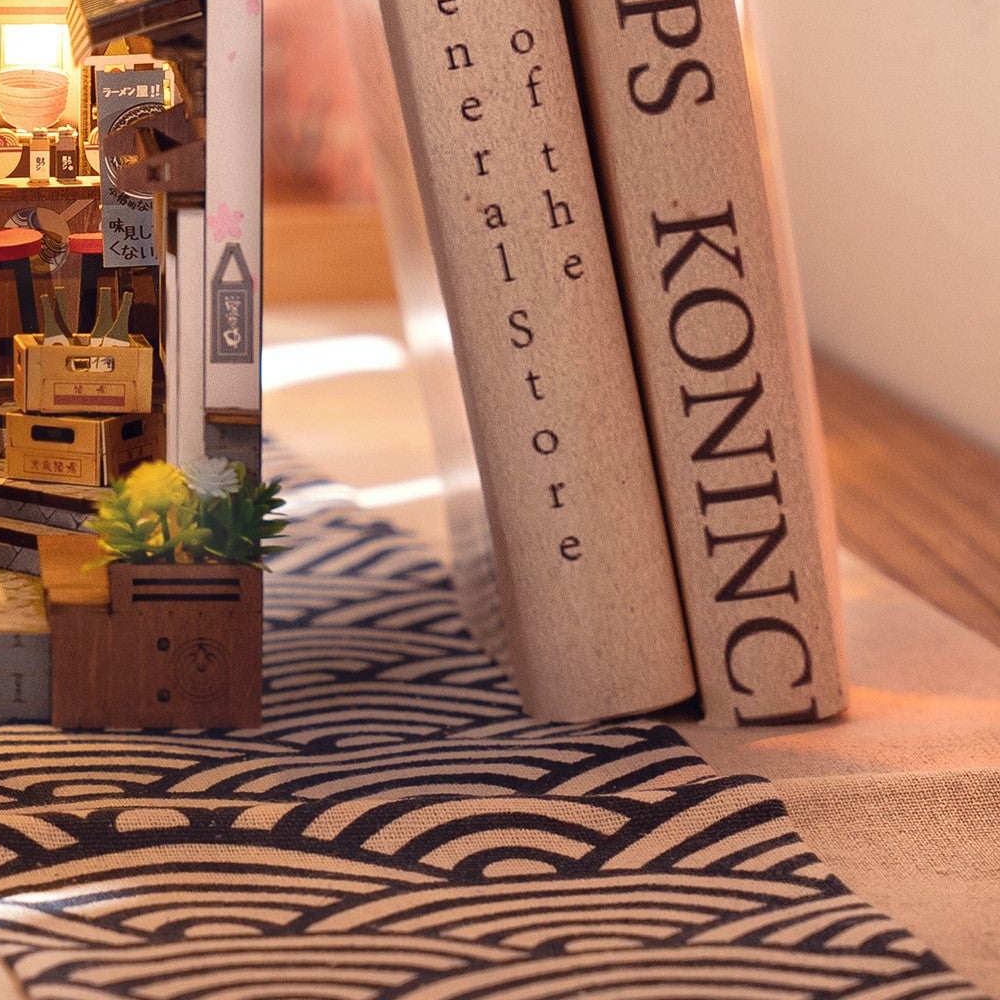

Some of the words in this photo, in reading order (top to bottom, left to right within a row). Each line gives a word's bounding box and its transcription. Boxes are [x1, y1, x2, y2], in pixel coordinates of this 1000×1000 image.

[510, 28, 544, 108] of
[540, 143, 585, 280] the
[508, 310, 582, 561] Store
